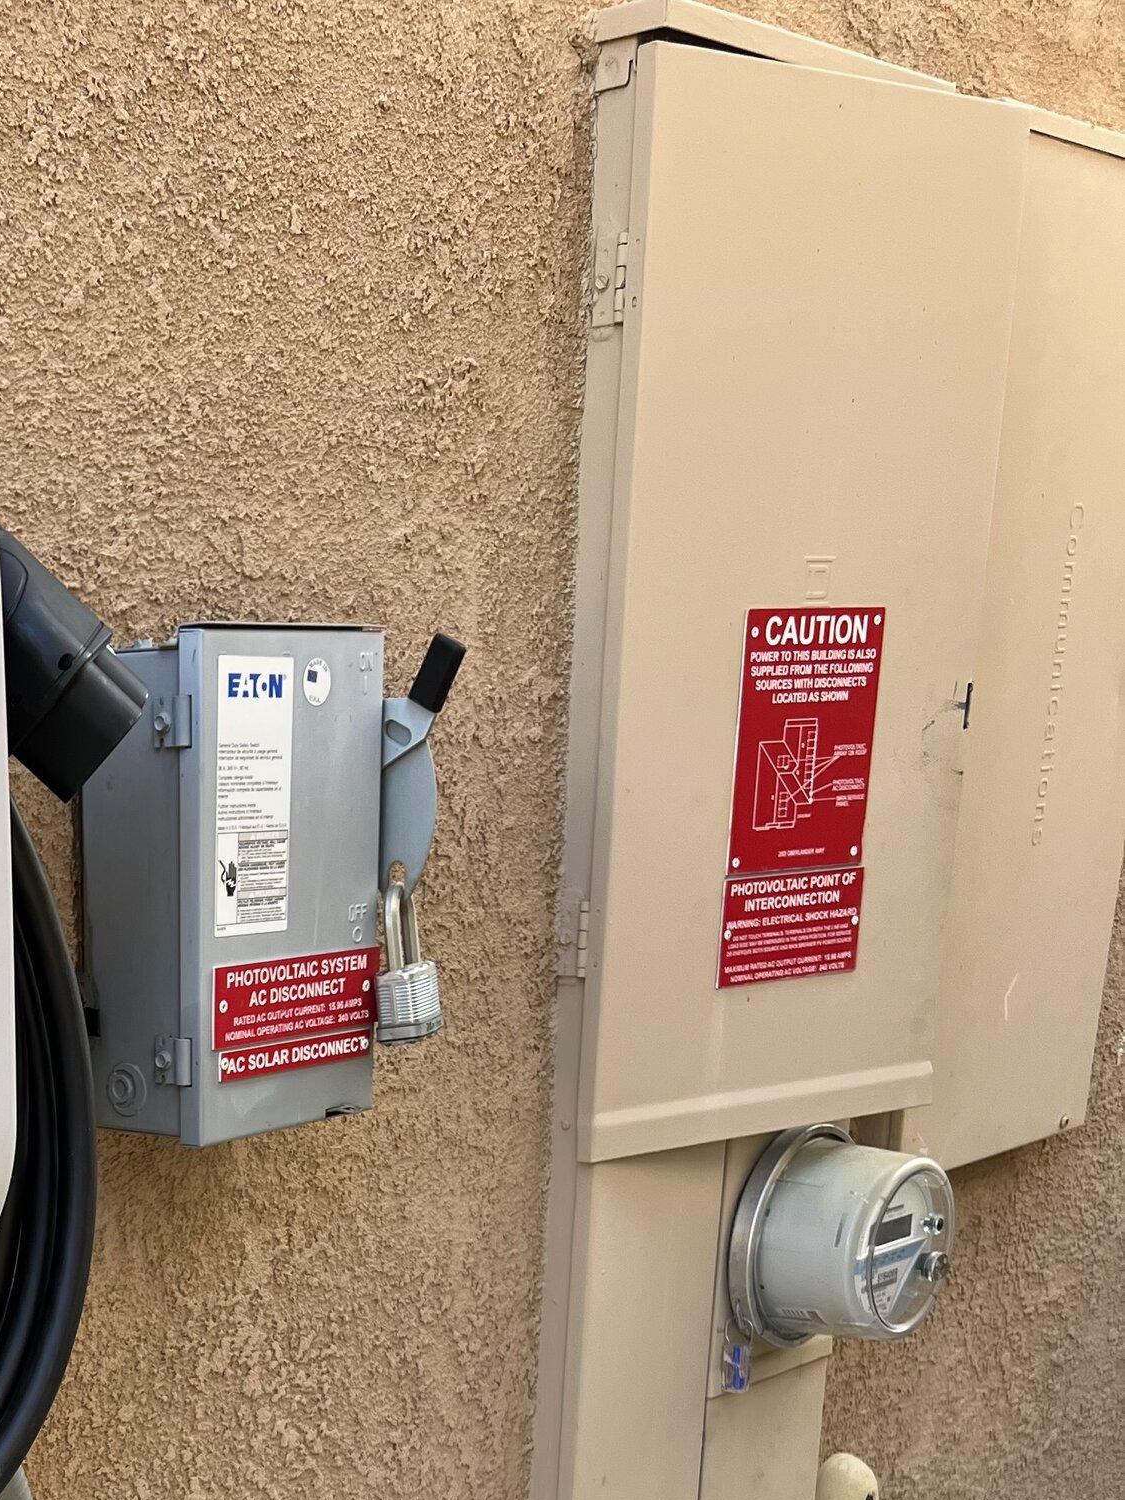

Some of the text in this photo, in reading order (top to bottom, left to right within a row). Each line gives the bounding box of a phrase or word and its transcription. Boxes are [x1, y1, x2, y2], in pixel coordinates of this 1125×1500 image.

[765, 614, 869, 646] CAUTION
[750, 648, 876, 662] POWER TO THIS BUILDING IS ALSO
[751, 662, 874, 676] SUPPLIED FROM THE FOLLOWING
[228, 673, 283, 698] EATON
[756, 676, 867, 691] SOURCES WITH DISCONNECTS
[772, 690, 849, 704] LOCATED AS SHOWN
[730, 872, 856, 896] PHOTOVOLTAIC POINT OF
[348, 903, 368, 923] OFF
[744, 890, 840, 912] INTERCONNECTION
[726, 907, 858, 930] WARNING: ELECTRICAL SHOCK HAZARD
[226, 954, 368, 988] PHOTOVOLTAIC SYSTEM
[248, 978, 346, 1008] AC DISCONNECT
[233, 1014, 256, 1026] RATED
[256, 1012, 267, 1024] AC
[267, 1007, 294, 1022] OUTPUT
[294, 1003, 326, 1018] CURRENT:
[344, 998, 363, 1009] AMPS
[225, 1028, 256, 1042] NOMINAL
[257, 1022, 294, 1037] OPERATING
[294, 1020, 304, 1030] AC
[304, 1015, 336, 1028] VOLTAGE:
[350, 1009, 369, 1021] VOLTS
[226, 1036, 364, 1075] AC SOLAR DISCONNECT
